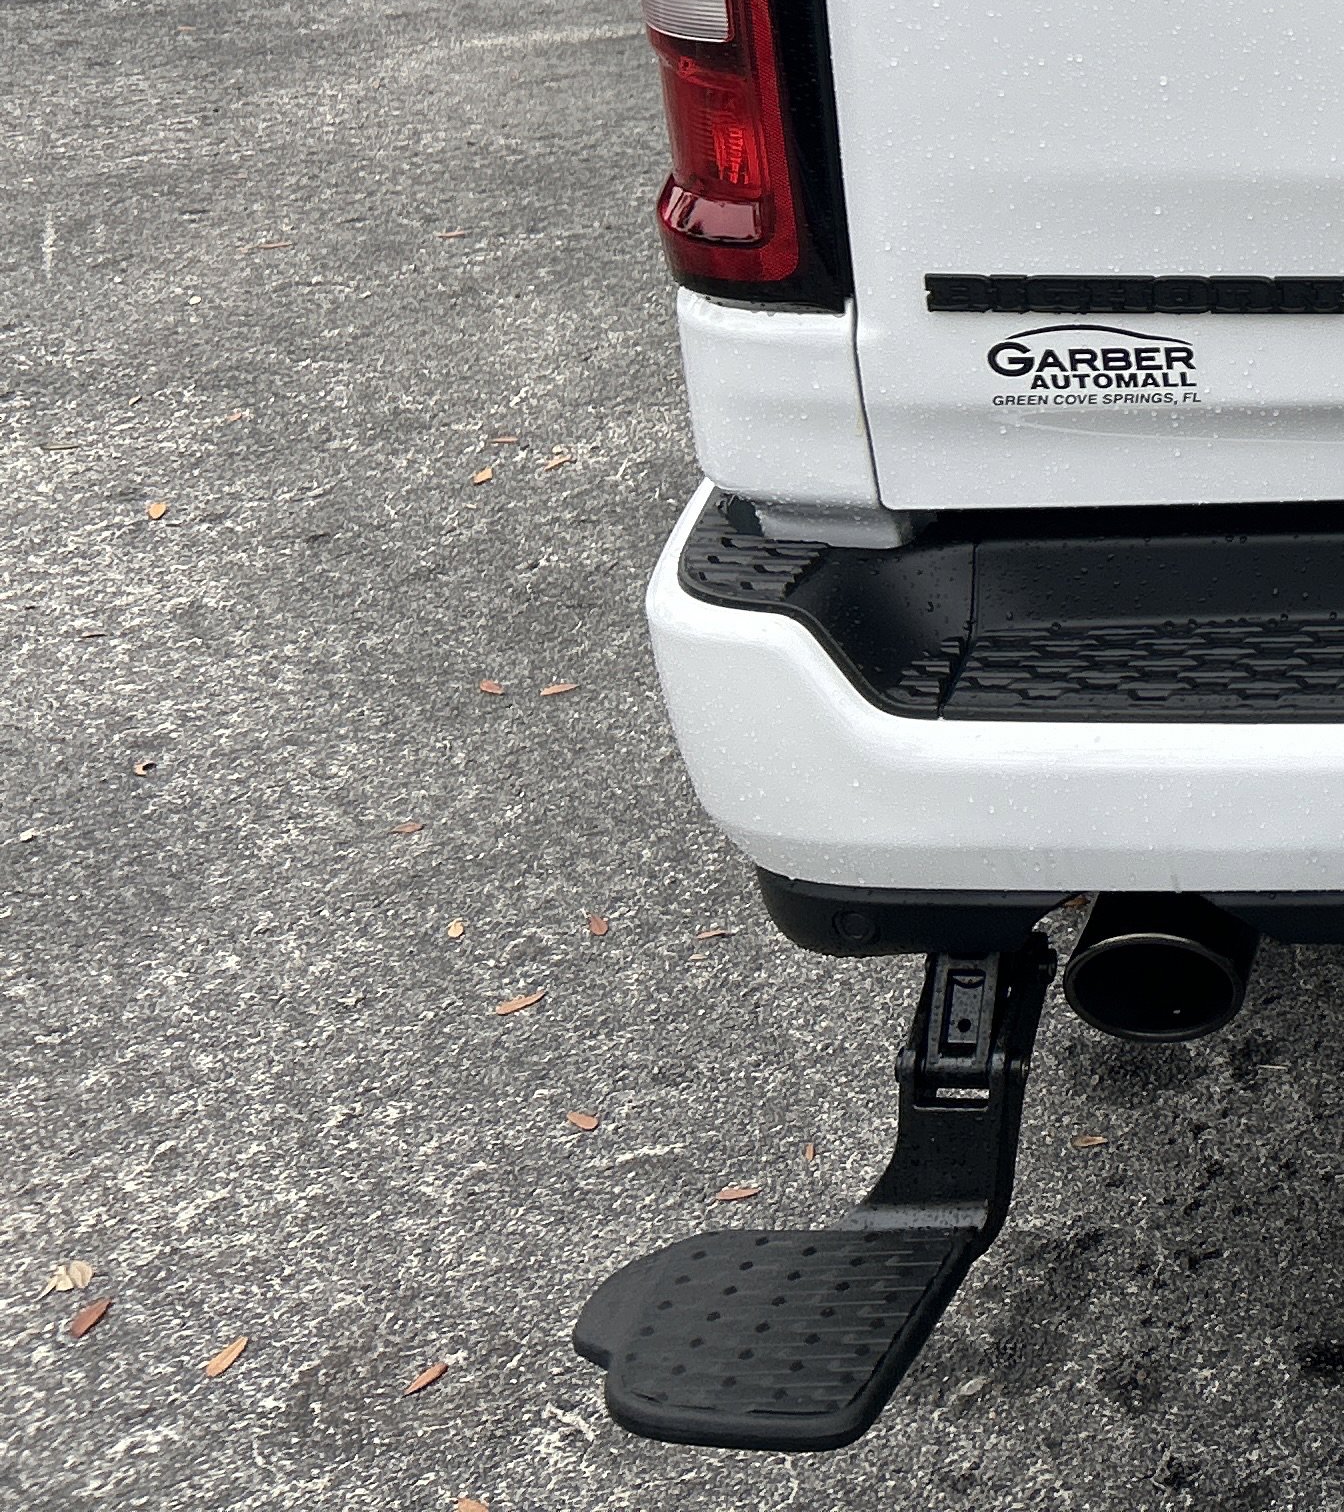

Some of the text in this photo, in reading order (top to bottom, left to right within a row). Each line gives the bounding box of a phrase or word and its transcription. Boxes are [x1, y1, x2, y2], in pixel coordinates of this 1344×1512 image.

[987, 341, 1196, 377] GARBER
[1030, 372, 1197, 389] AUTOMALL
[992, 392, 1201, 406] GREEN COVE SPRINGS, FL
